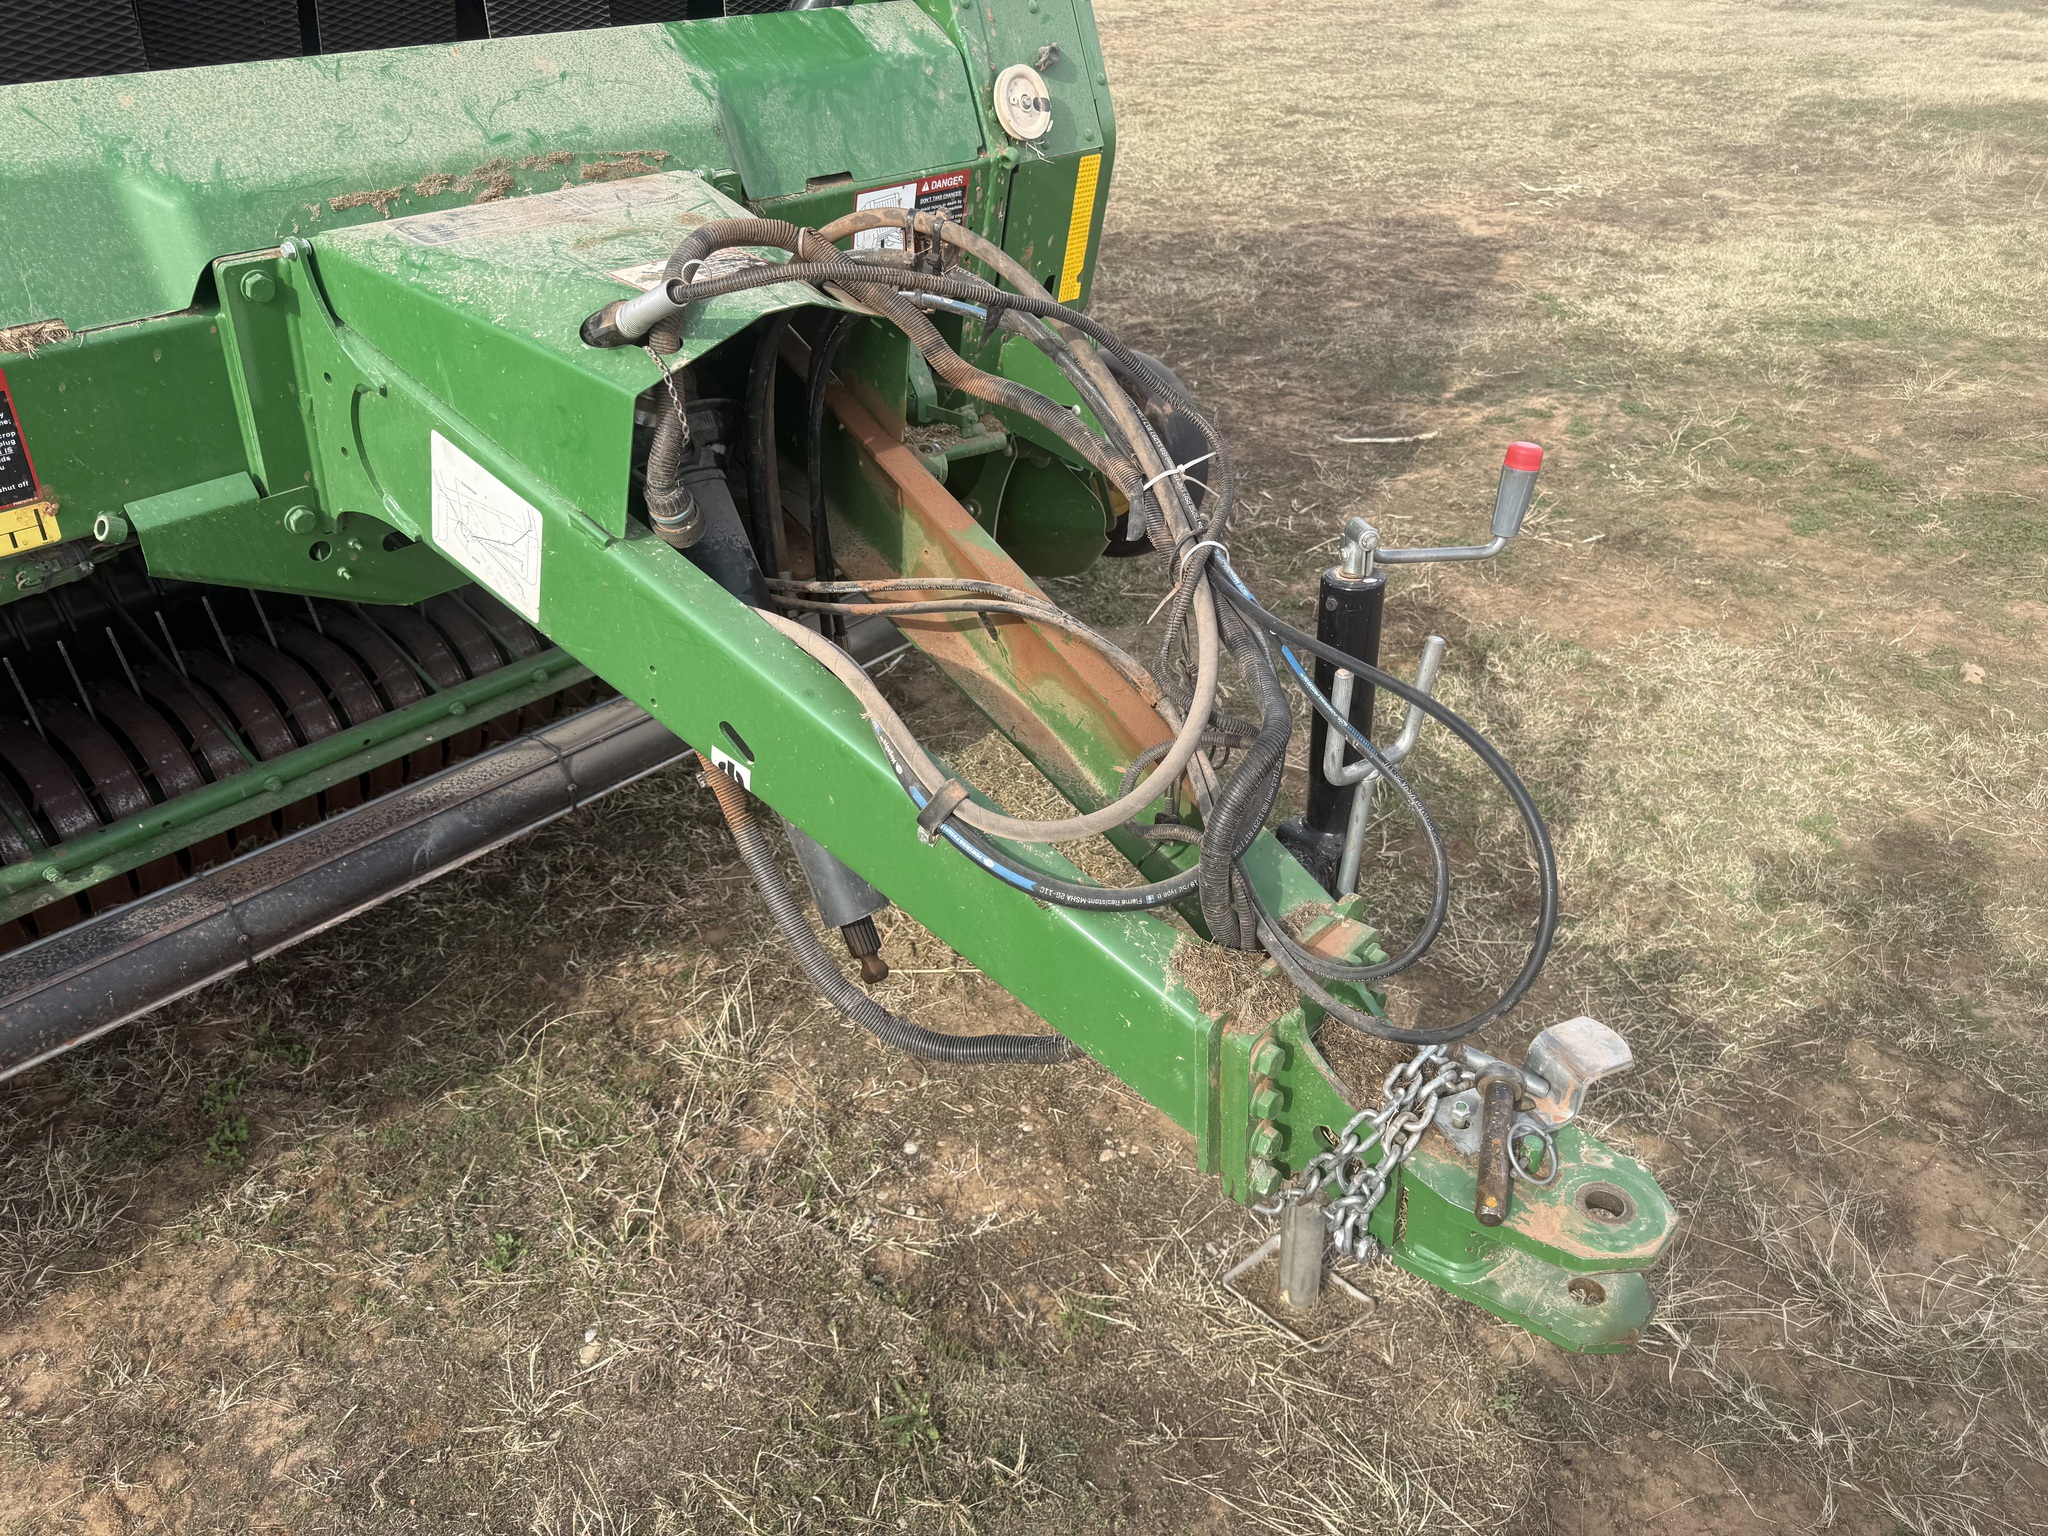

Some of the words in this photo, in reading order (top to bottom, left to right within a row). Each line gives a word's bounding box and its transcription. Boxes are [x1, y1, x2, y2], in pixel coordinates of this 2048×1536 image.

[931, 175, 963, 190] DANGER
[1260, 801, 1270, 812] ISO
[1250, 812, 1264, 831] 11237
[1242, 830, 1253, 843] R17
[959, 840, 984, 858] POWERING
[1230, 844, 1242, 858] SAE
[1038, 885, 1065, 899] 2G-11C
[1066, 893, 1086, 903] MSHA
[1087, 897, 1119, 906] Resistant
[1120, 896, 1142, 906] Flame
